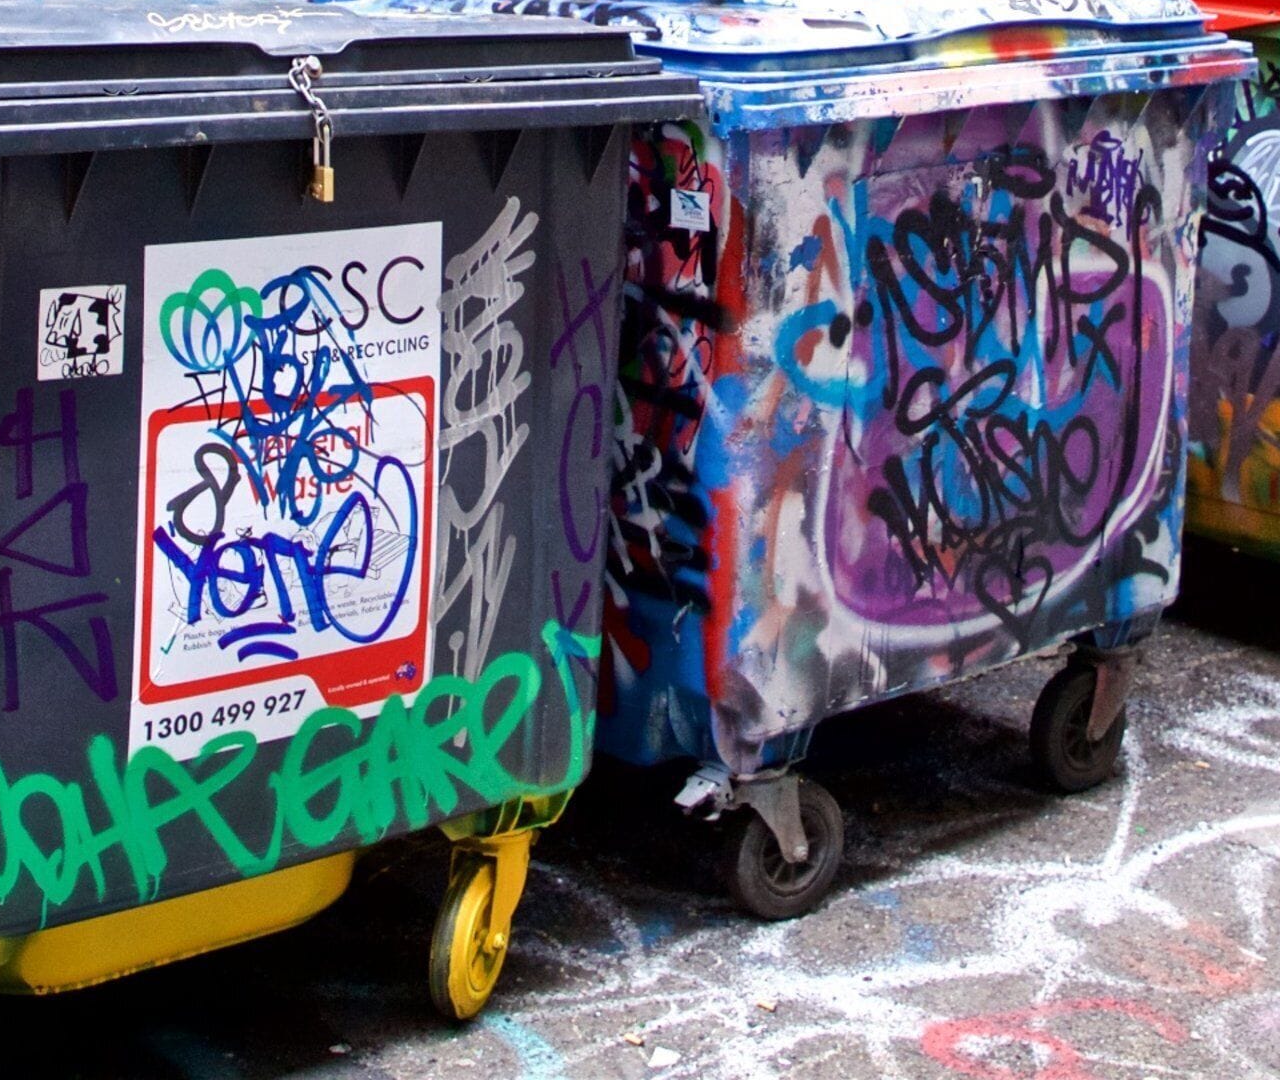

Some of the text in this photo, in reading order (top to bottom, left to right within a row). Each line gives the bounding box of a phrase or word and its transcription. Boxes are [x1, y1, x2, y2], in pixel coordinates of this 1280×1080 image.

[144, 688, 307, 742] 1300 499 927
